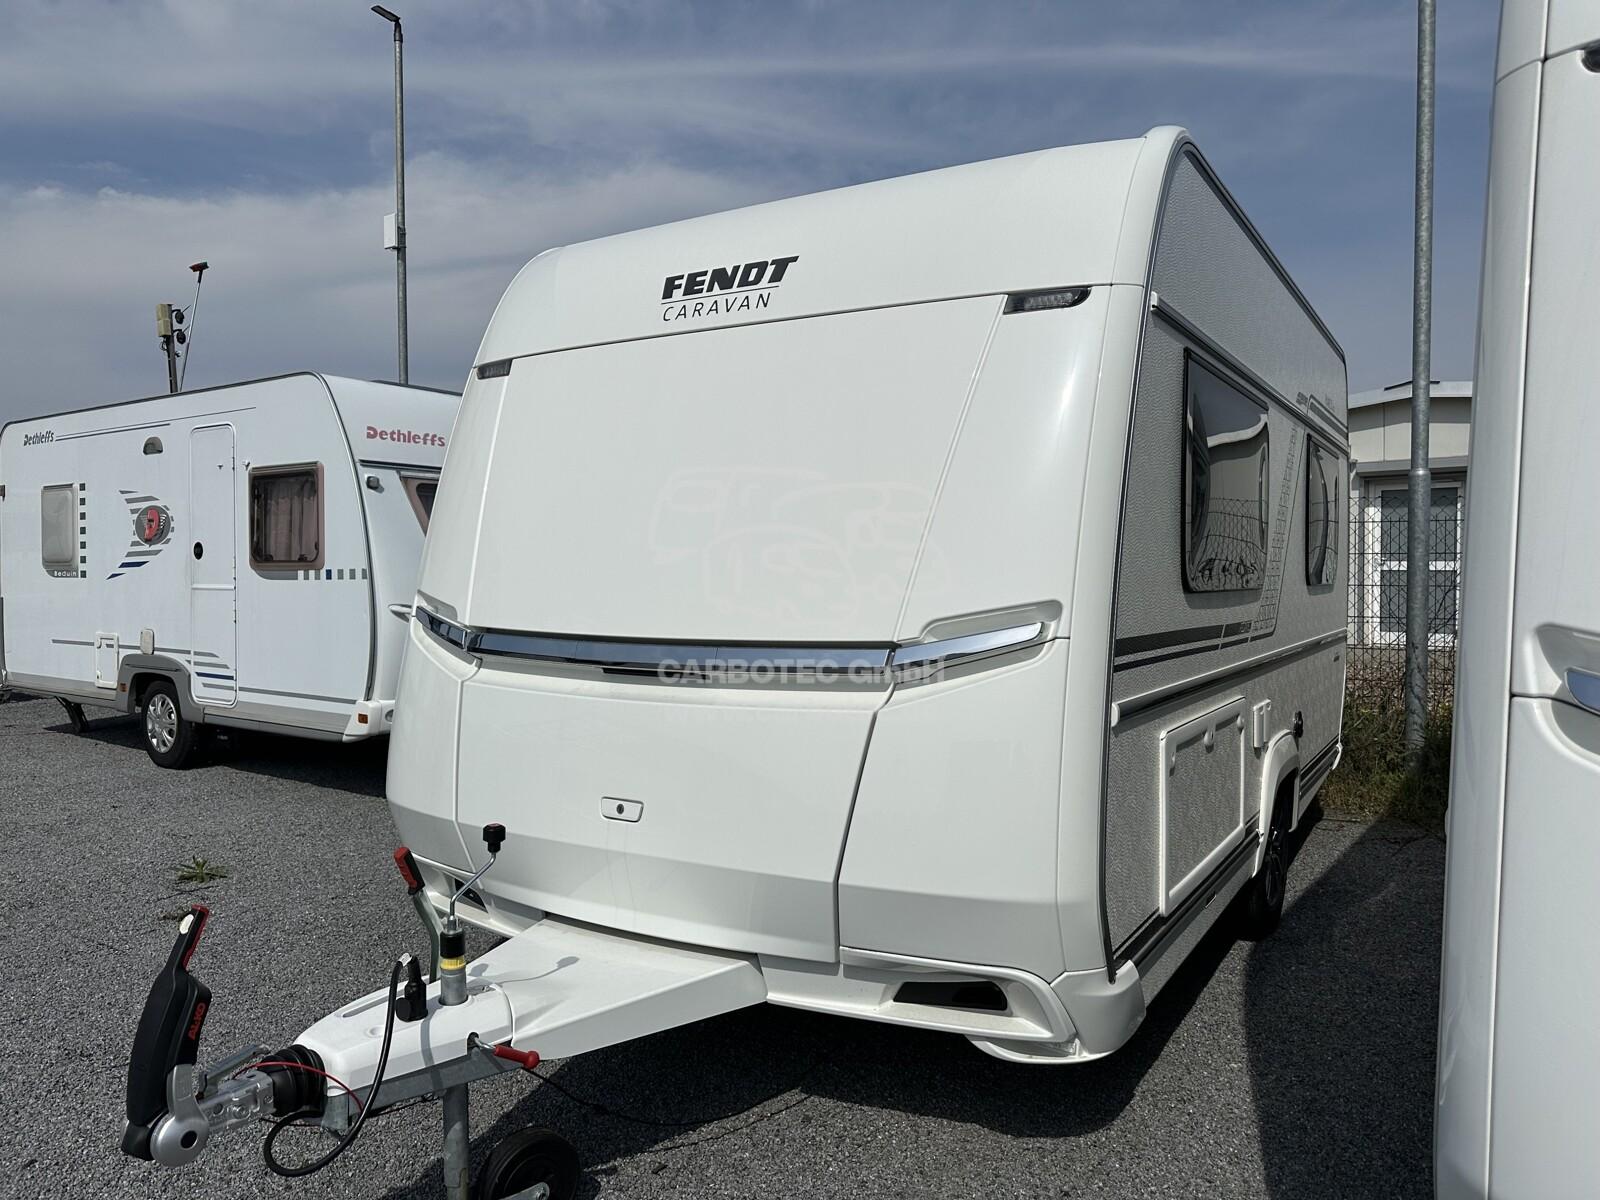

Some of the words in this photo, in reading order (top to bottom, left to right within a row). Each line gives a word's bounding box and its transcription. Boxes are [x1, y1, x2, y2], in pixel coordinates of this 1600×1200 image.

[661, 255, 799, 299] FENDT
[662, 292, 771, 322] CARAVAN
[23, 430, 54, 446] Dethleffs
[366, 425, 446, 447] Dethleffs
